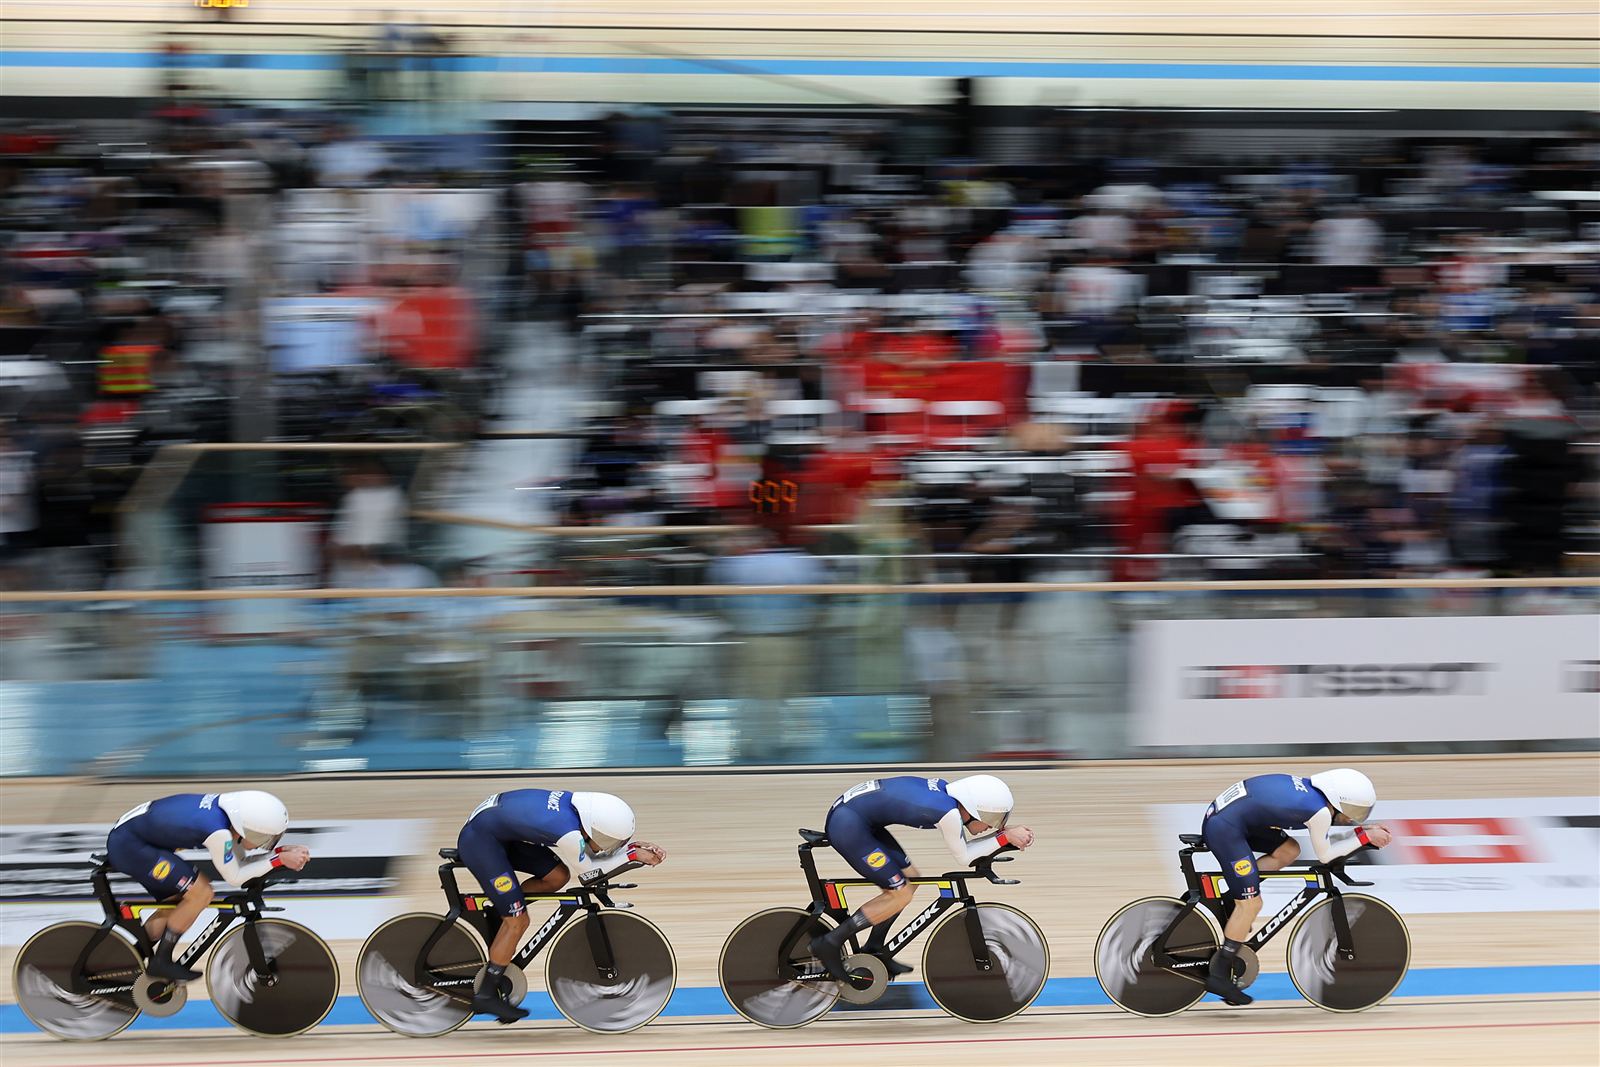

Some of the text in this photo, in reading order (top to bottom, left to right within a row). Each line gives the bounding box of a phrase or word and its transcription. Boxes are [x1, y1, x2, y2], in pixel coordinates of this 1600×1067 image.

[547, 791, 565, 812] FRANCE
[180, 915, 222, 966] LOOK
[521, 908, 564, 959] LOOK
[888, 900, 941, 952] LOOK
[1256, 890, 1307, 943] LOOK
